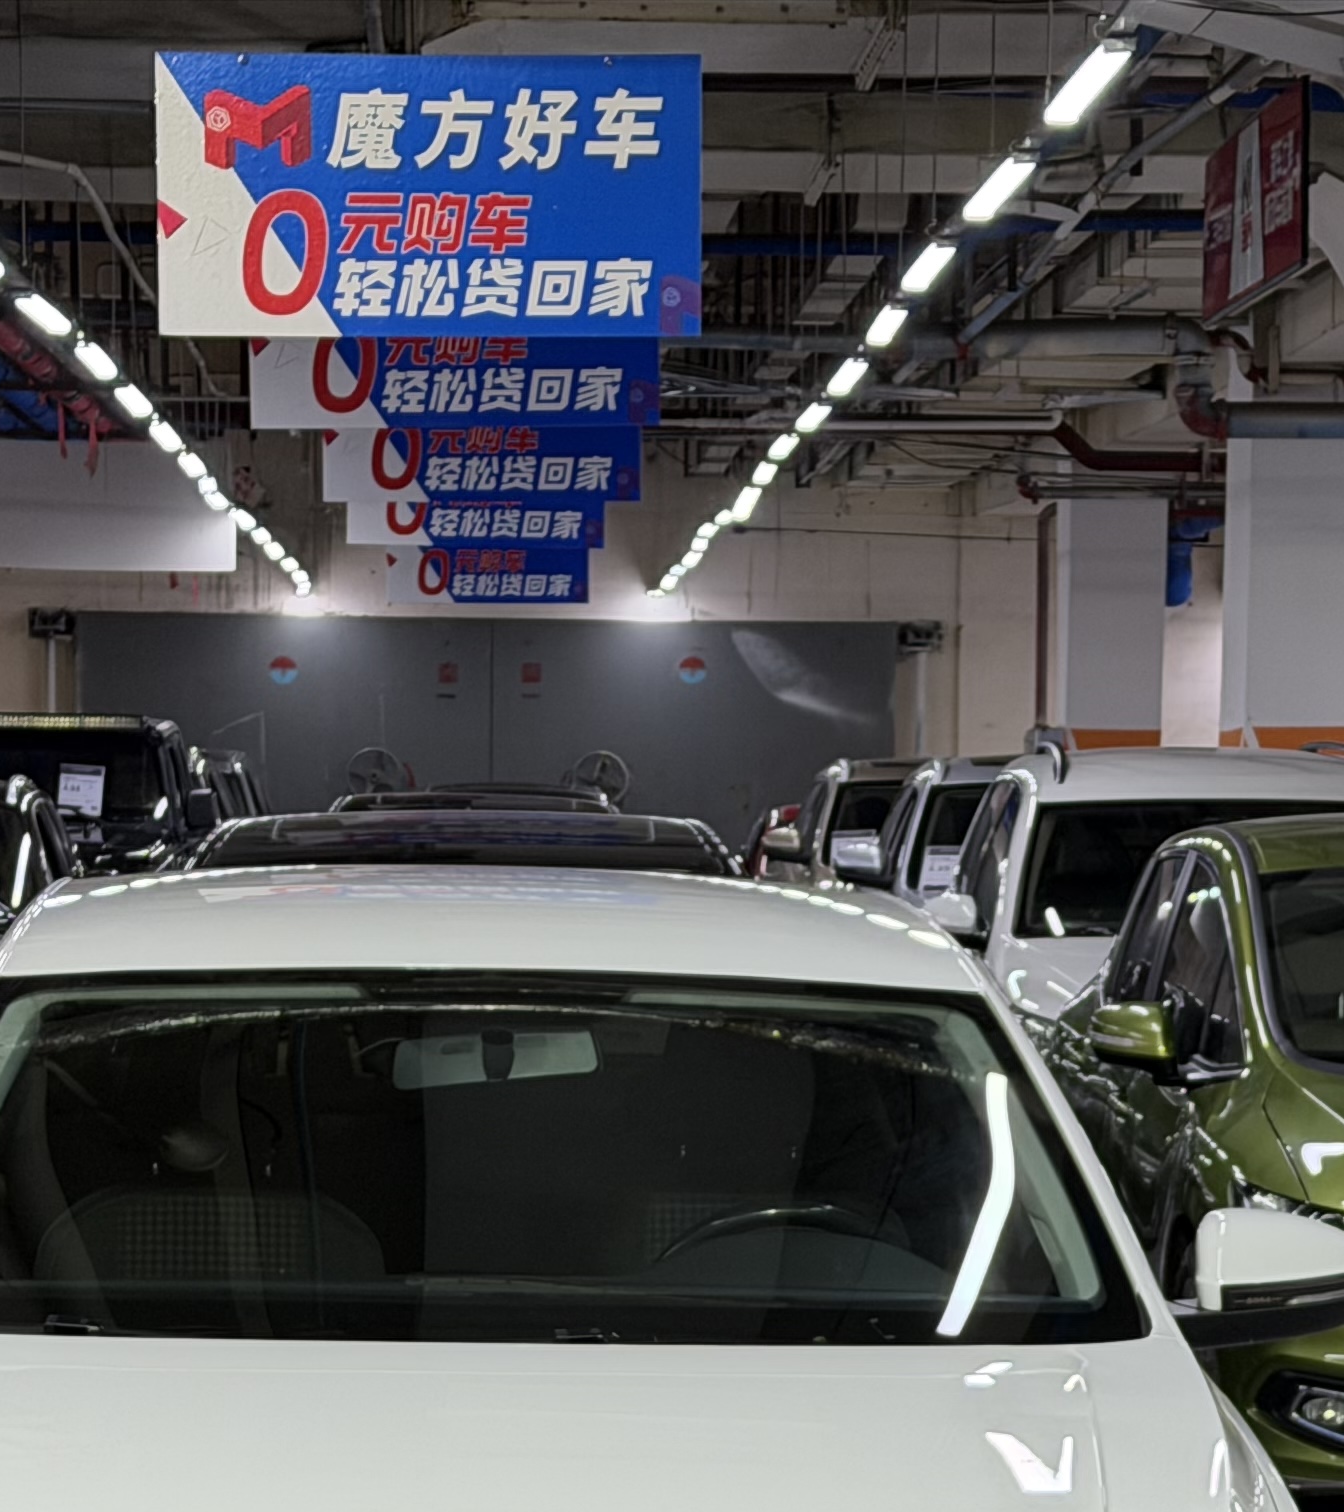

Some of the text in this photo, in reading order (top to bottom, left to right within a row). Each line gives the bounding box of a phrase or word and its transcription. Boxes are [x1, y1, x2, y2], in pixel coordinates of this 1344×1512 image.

[327, 89, 664, 169] 魔方好车
[333, 258, 654, 318] 轻松贷回家
[381, 367, 624, 414] 轻松贷回家
[424, 456, 614, 491] 轻松贷回家
[429, 510, 583, 540] 轻松贷回家
[452, 573, 573, 599] 轻松贷回家
